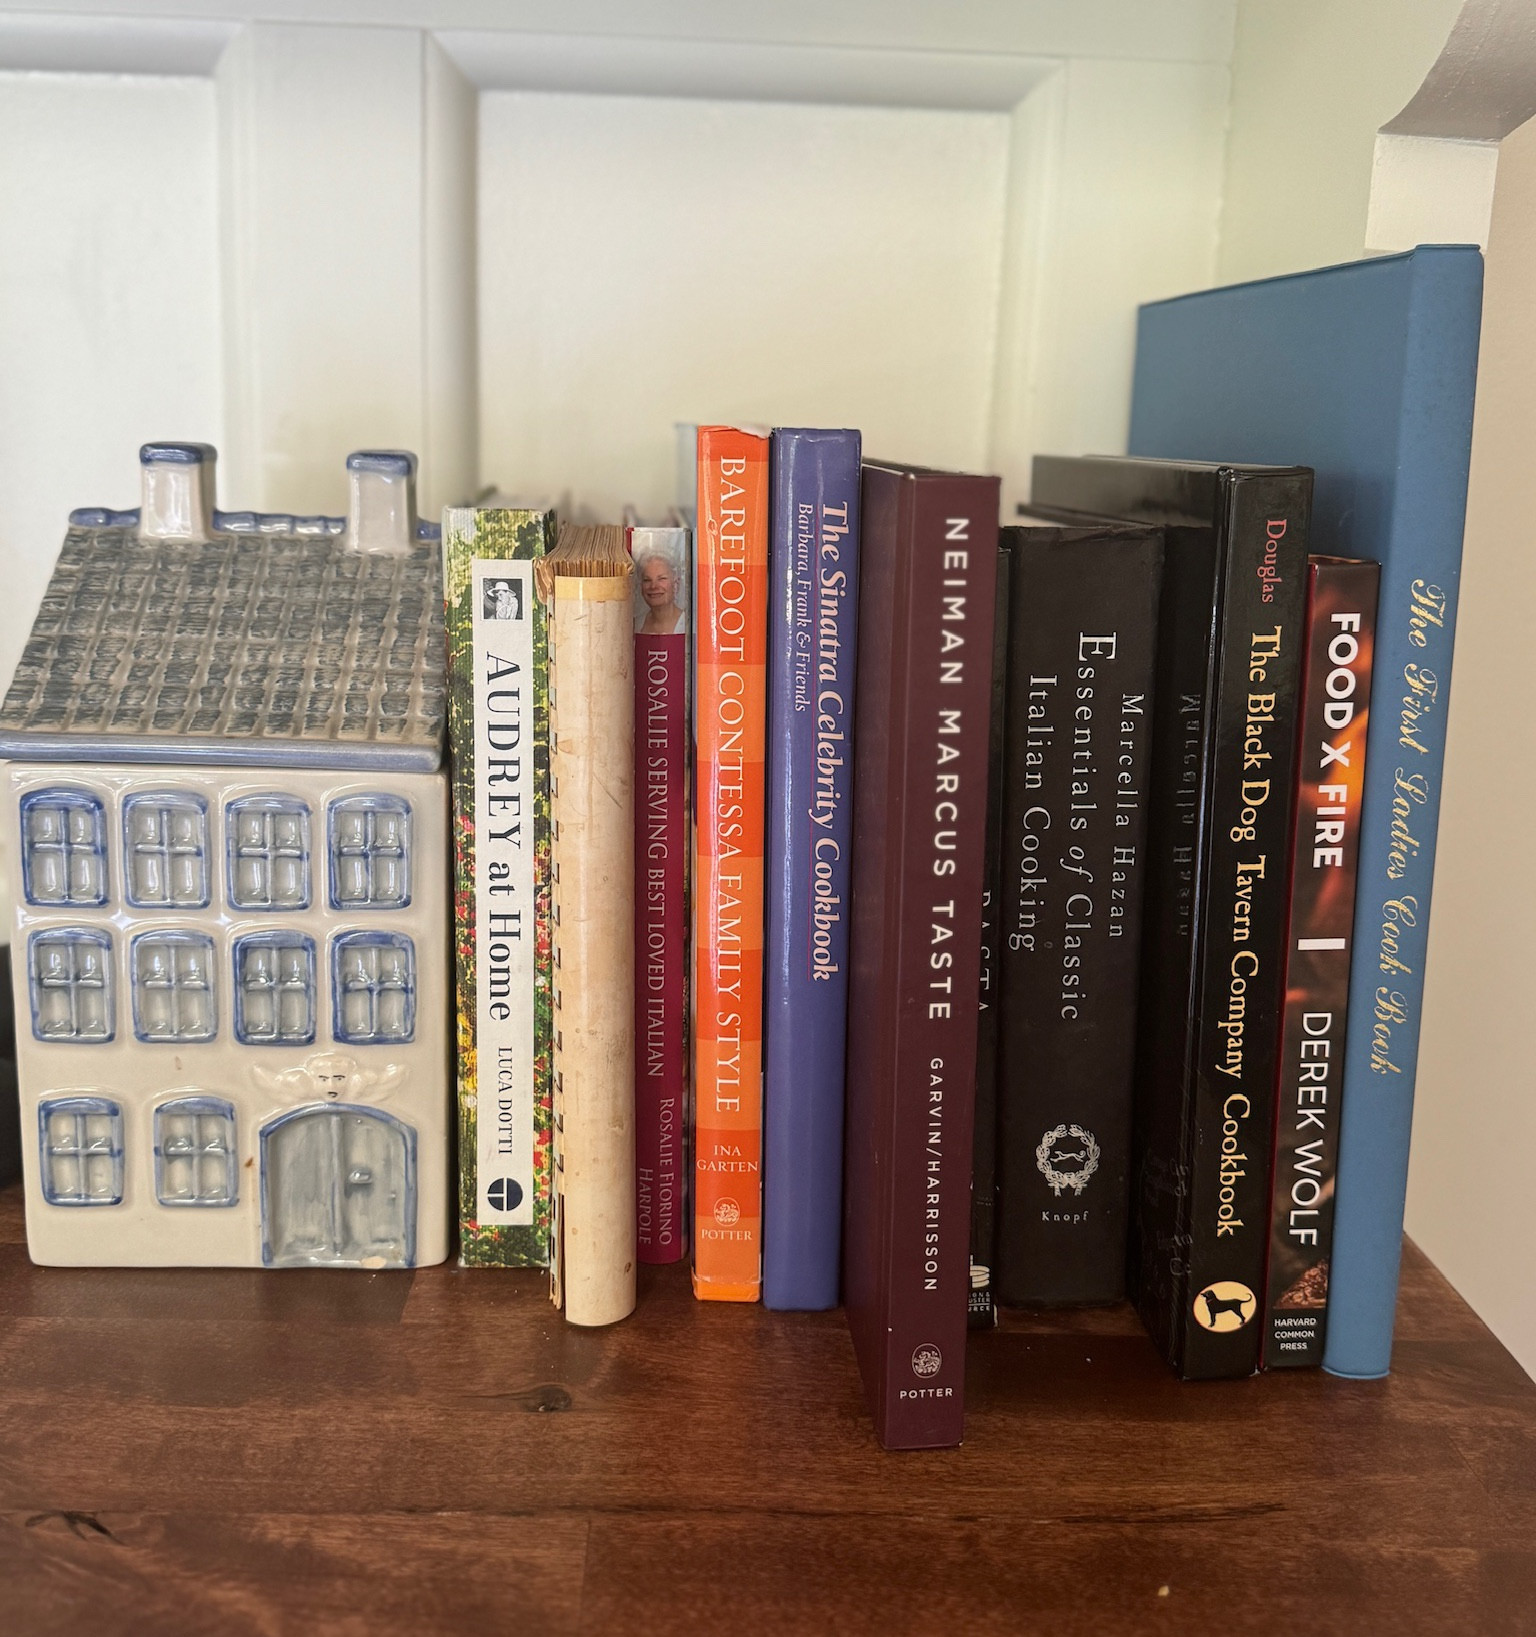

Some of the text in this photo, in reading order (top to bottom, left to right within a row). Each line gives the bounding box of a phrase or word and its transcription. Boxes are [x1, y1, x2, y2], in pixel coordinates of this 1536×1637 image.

[794, 503, 814, 712] Barbara, Frank & Friends
[486, 651, 522, 1021] AUDREY at Home
[715, 456, 746, 1112] BAREFOOT CONTESSA FAMILY STYLE
[808, 501, 850, 981] The Sinatra Celebrity Cookbook
[929, 518, 970, 1020] NEIMAN MARCUS TASTE
[1008, 674, 1058, 952] Italian Cooking
[1059, 632, 1118, 1020] Essentials of Classic
[1108, 693, 1146, 938] Marcella Hazan
[1313, 612, 1361, 869] FOOD X FIRE
[1370, 578, 1446, 1075] The First Ladies Cook Book
[646, 650, 668, 1077] ROSALIE SERVING BEST LOVED ITALIAN
[1215, 518, 1288, 1239] Douglas The Black Dog Tavern Company Cookbook
[497, 1046, 513, 1154] LUCA DOTTI
[637, 1167, 654, 1245] HARPOLE
[658, 1097, 675, 1245] ROSALIE FIORINO
[696, 1158, 759, 1173] GARTEN
[714, 1144, 742, 1157] INA
[924, 1057, 944, 1290] GARVIN/HARRISSON
[1288, 1011, 1333, 1247] DEREK WOLF
[701, 1228, 753, 1241] POTTER
[1041, 1210, 1088, 1224] Knopf
[1274, 1317, 1317, 1329] HARVARD
[899, 1387, 953, 1400] POTTER
[1274, 1330, 1315, 1340] COMMON
[1280, 1341, 1308, 1351] PRESS
